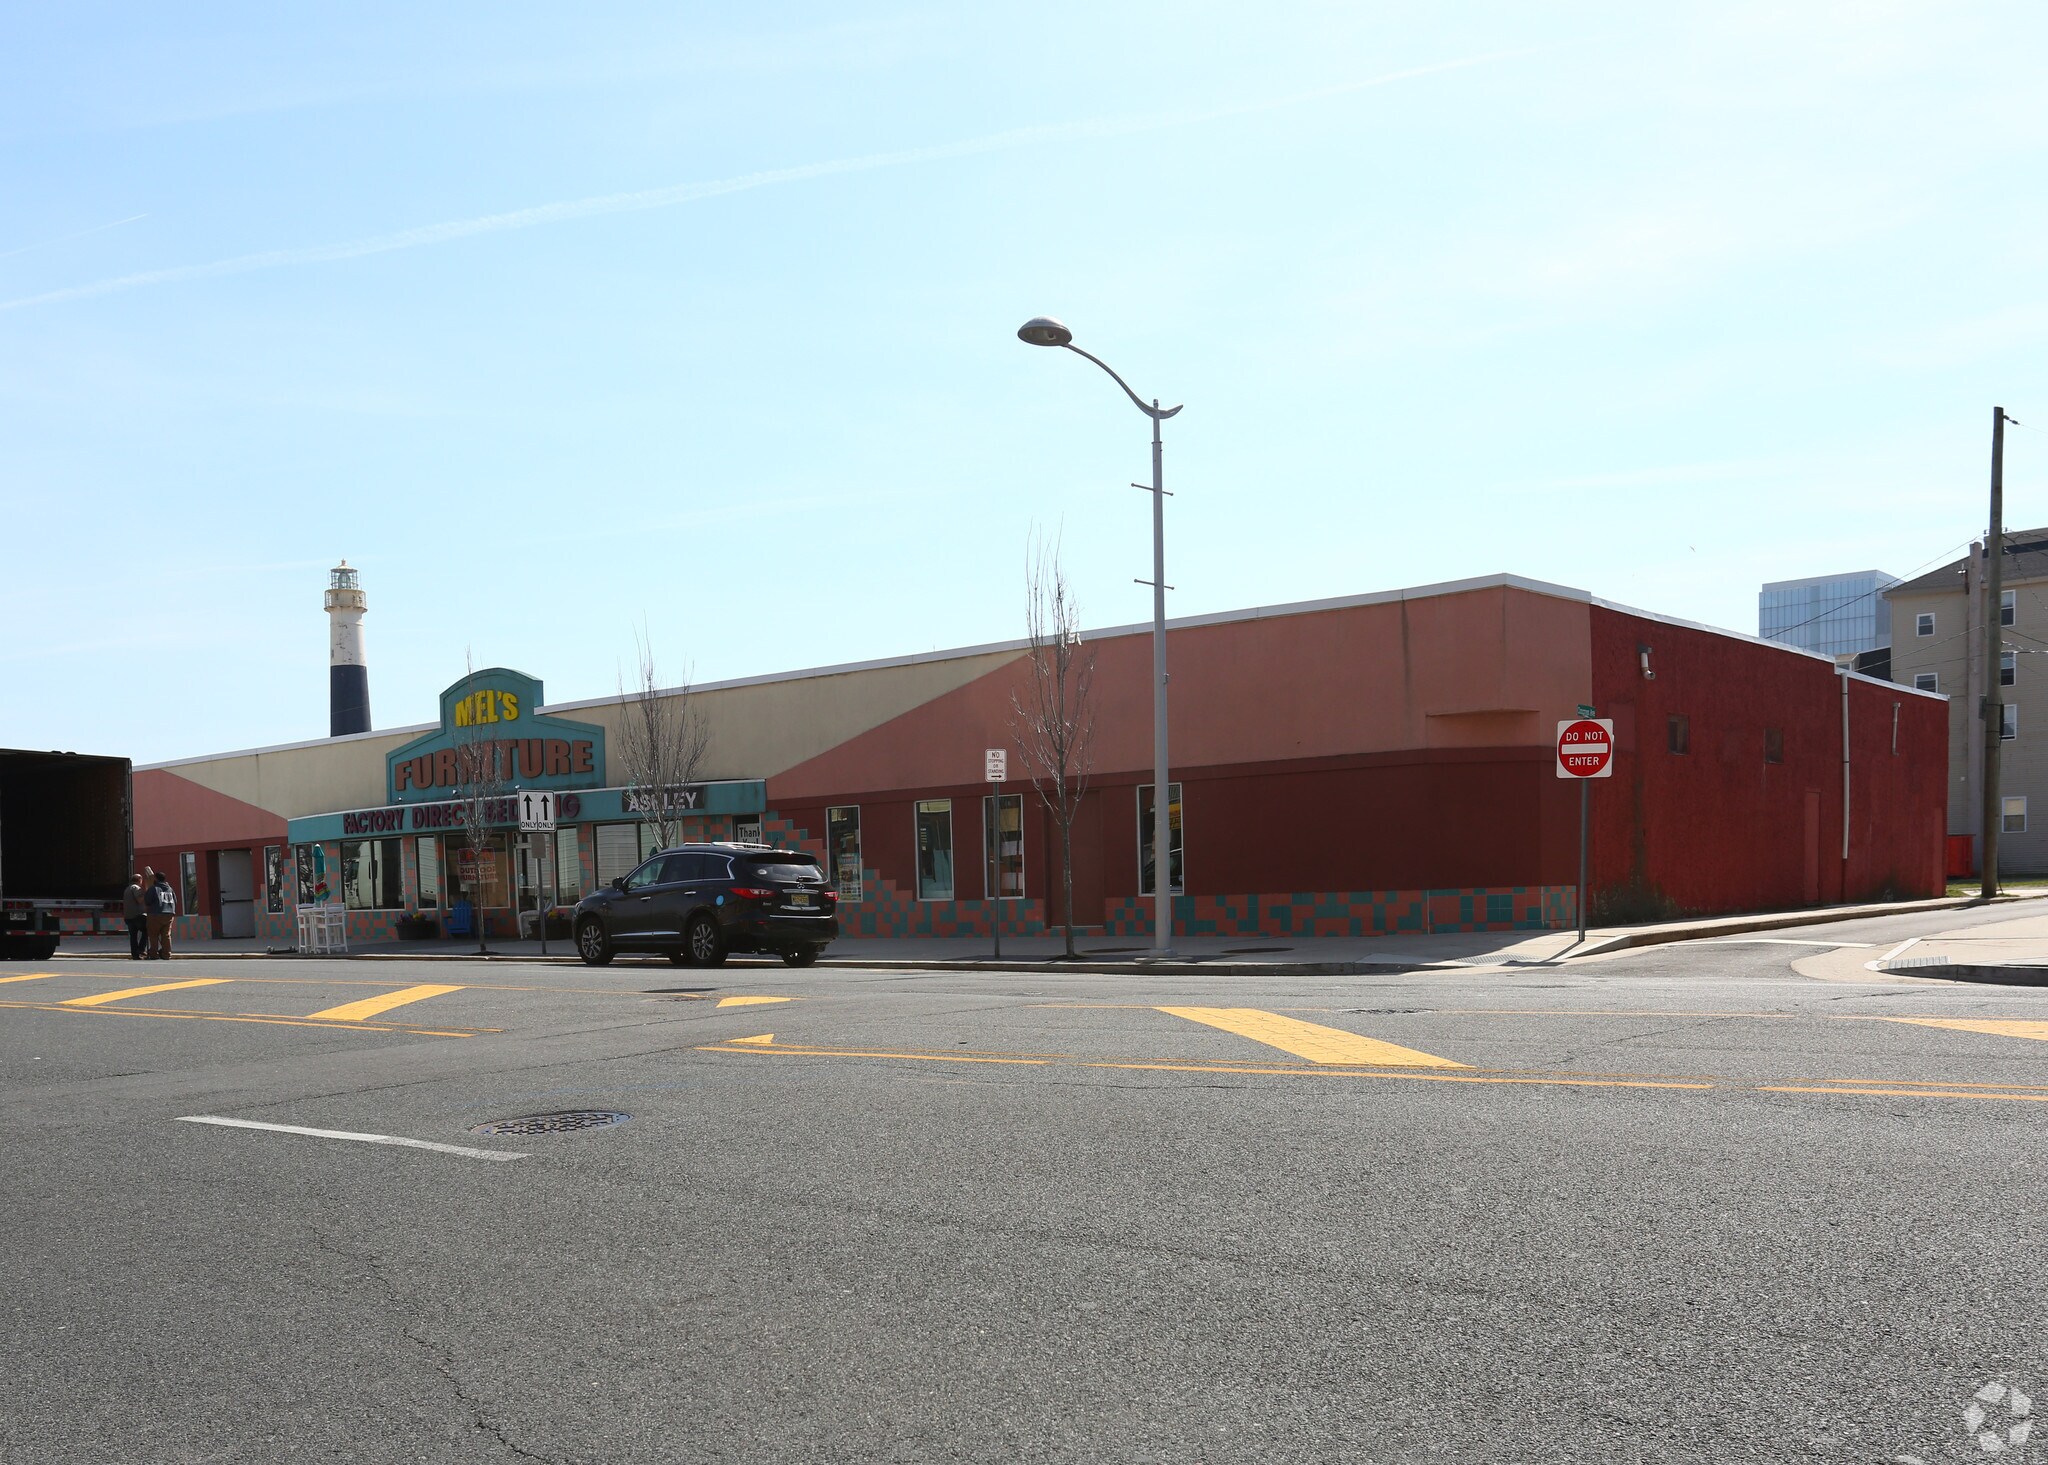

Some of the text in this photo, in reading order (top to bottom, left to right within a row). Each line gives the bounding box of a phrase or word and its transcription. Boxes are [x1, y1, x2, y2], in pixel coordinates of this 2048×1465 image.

[455, 689, 519, 727] MEL'S
[1566, 731, 1603, 741] DO NOT
[395, 739, 594, 791] FURNITURE
[1569, 757, 1599, 766] ENTER
[343, 809, 405, 834] FACTORY
[521, 821, 554, 829] ONLY ONLY
